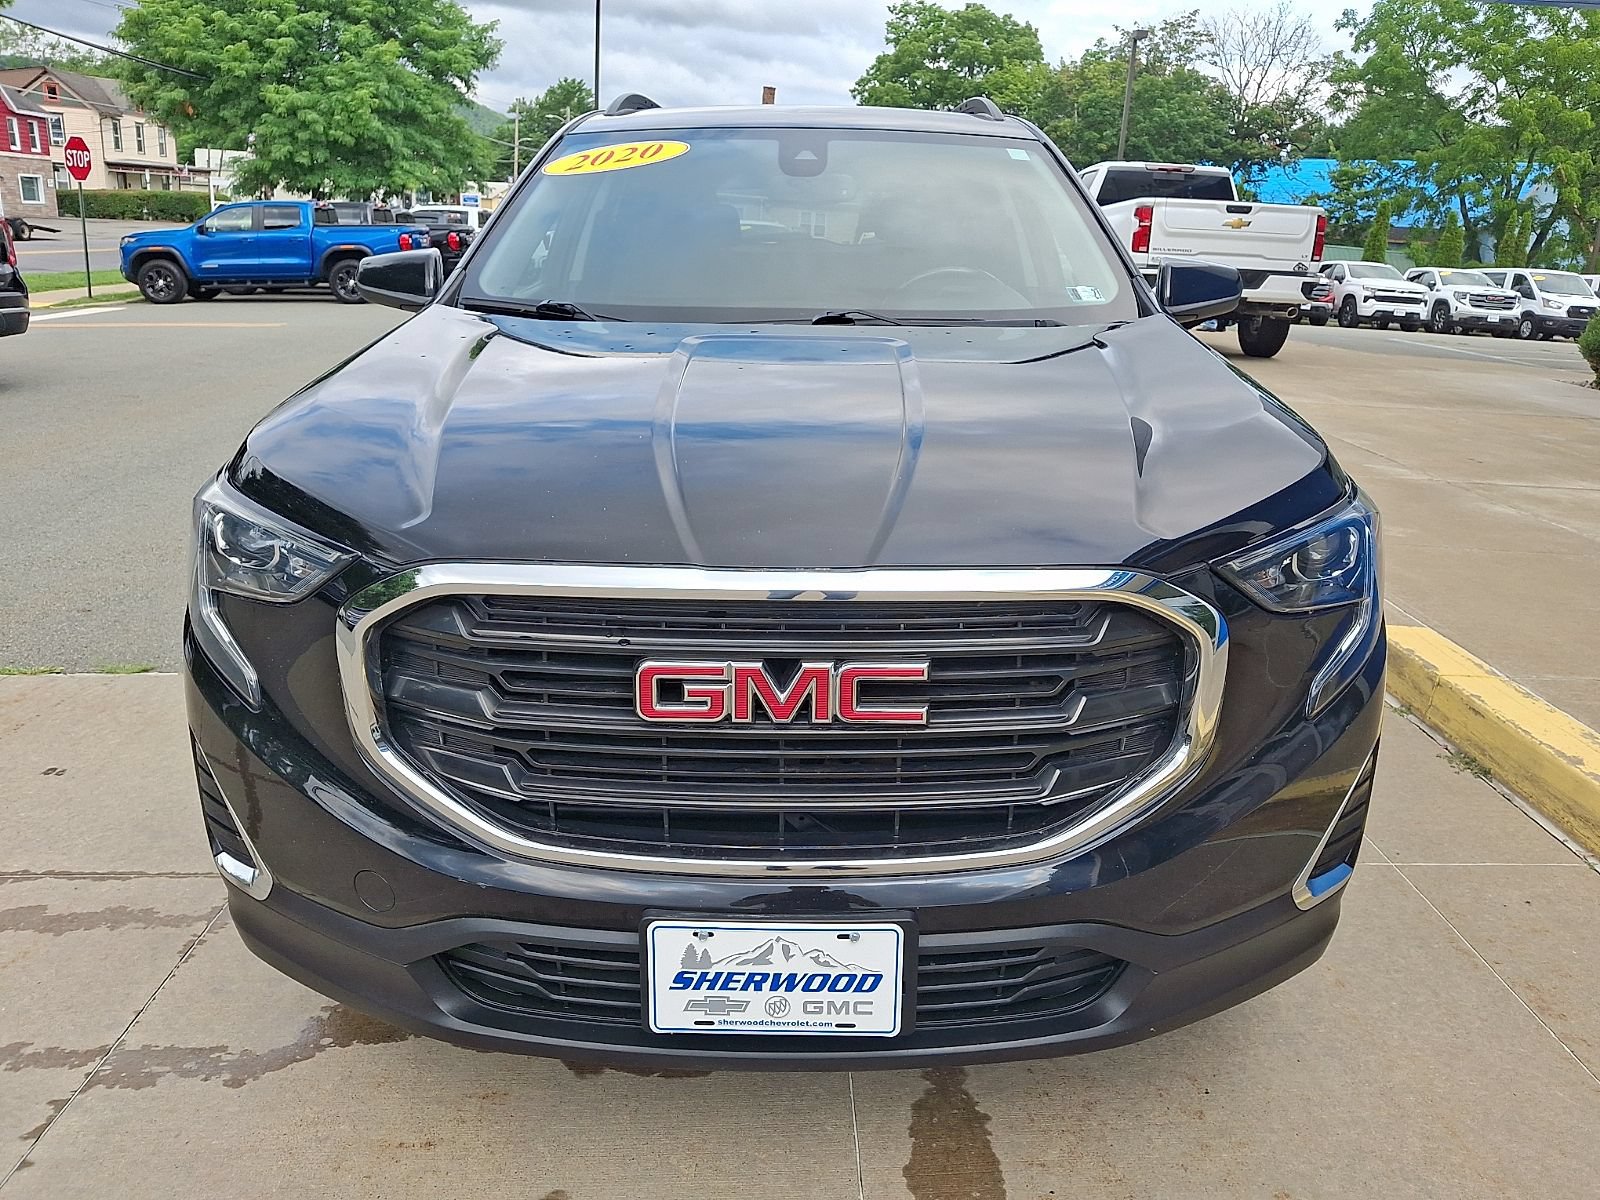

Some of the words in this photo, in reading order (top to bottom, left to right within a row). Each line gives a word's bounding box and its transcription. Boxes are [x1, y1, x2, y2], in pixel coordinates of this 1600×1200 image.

[66, 149, 90, 168] STOP
[564, 143, 664, 172] 2020
[635, 658, 931, 725] GMC
[669, 970, 883, 993] SHERWOOD
[802, 1000, 874, 1016] GMC
[717, 1018, 834, 1029] sherwoodchevrolet.com
